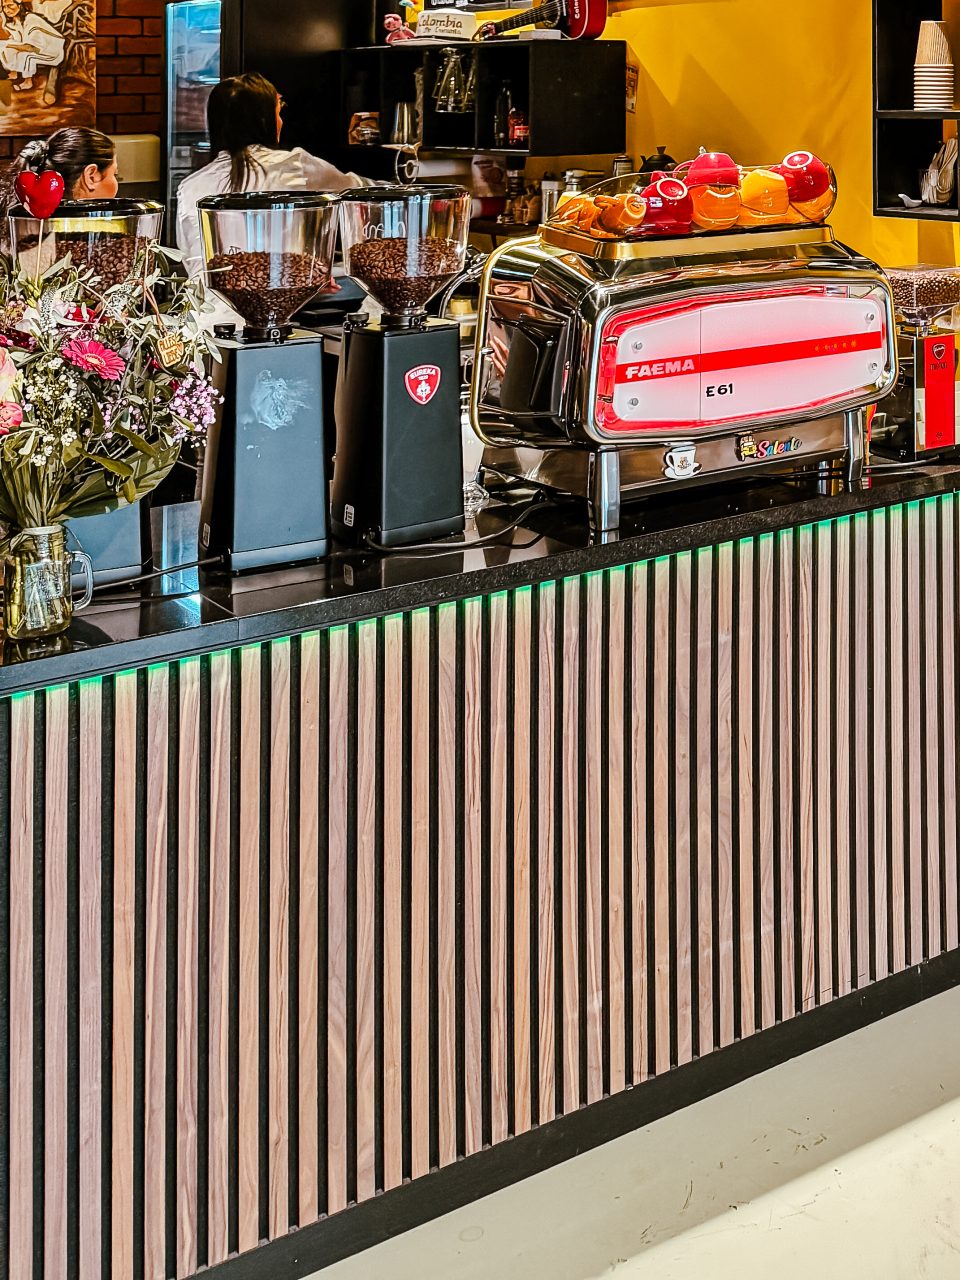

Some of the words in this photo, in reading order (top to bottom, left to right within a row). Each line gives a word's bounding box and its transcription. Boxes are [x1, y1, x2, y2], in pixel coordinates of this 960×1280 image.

[409, 368, 436, 380] EUREKA
[625, 359, 695, 379] FAEMA
[706, 385, 715, 398] E
[717, 383, 733, 395] 61
[757, 437, 802, 458] Salento
